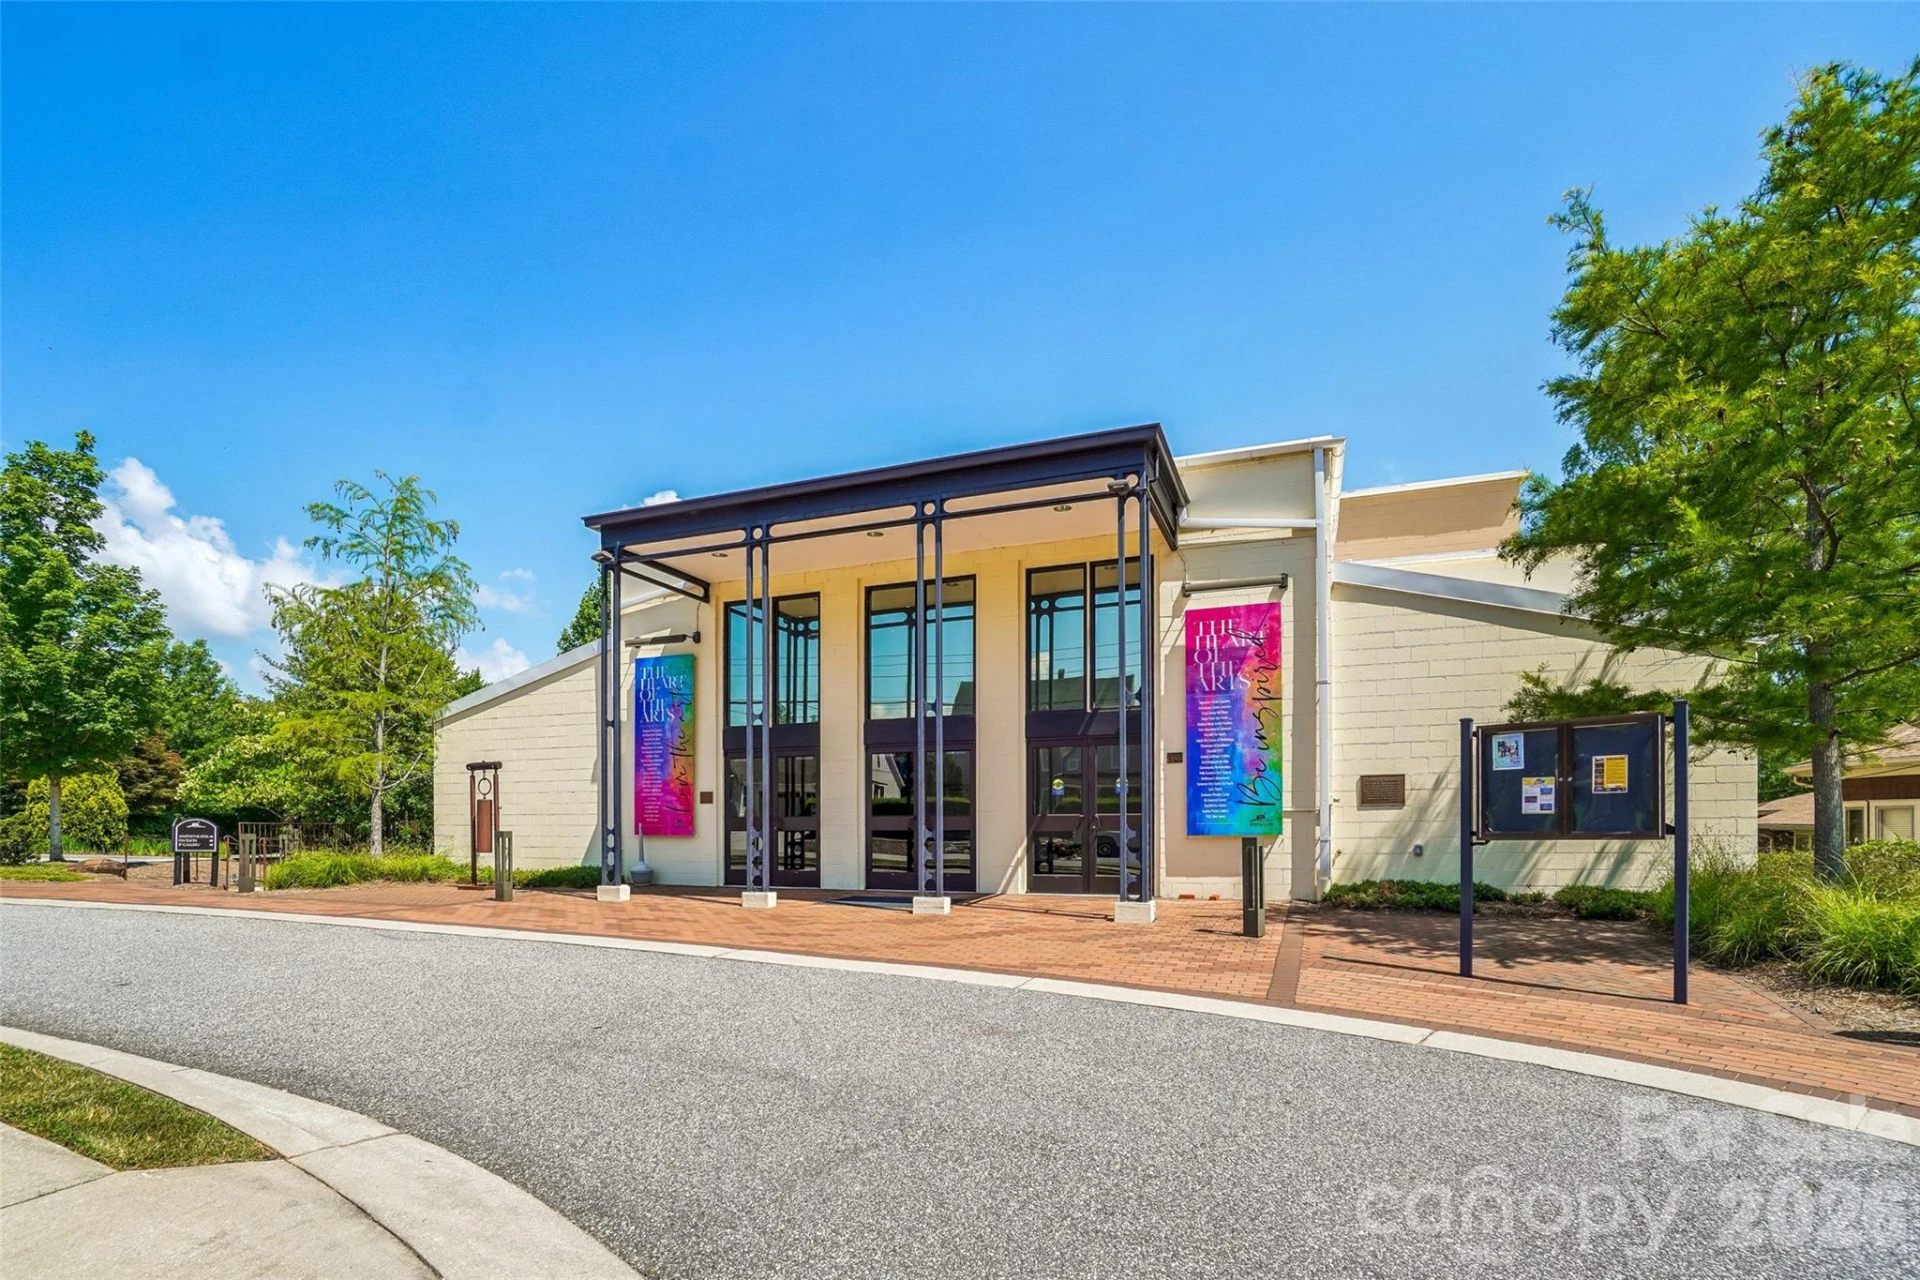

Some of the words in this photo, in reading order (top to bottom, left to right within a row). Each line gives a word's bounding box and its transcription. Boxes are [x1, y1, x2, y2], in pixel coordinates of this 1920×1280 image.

[1193, 618, 1240, 637] THE
[1194, 628, 1270, 651] HEART
[1193, 646, 1221, 664] OF
[639, 665, 669, 680] THE
[1193, 659, 1240, 678] THE
[640, 675, 688, 690] HEART
[1194, 672, 1252, 692] ARTS
[639, 688, 658, 702] OF
[639, 698, 668, 713] THE
[639, 708, 675, 723] ARTS
[1236, 758, 1282, 806] Be
